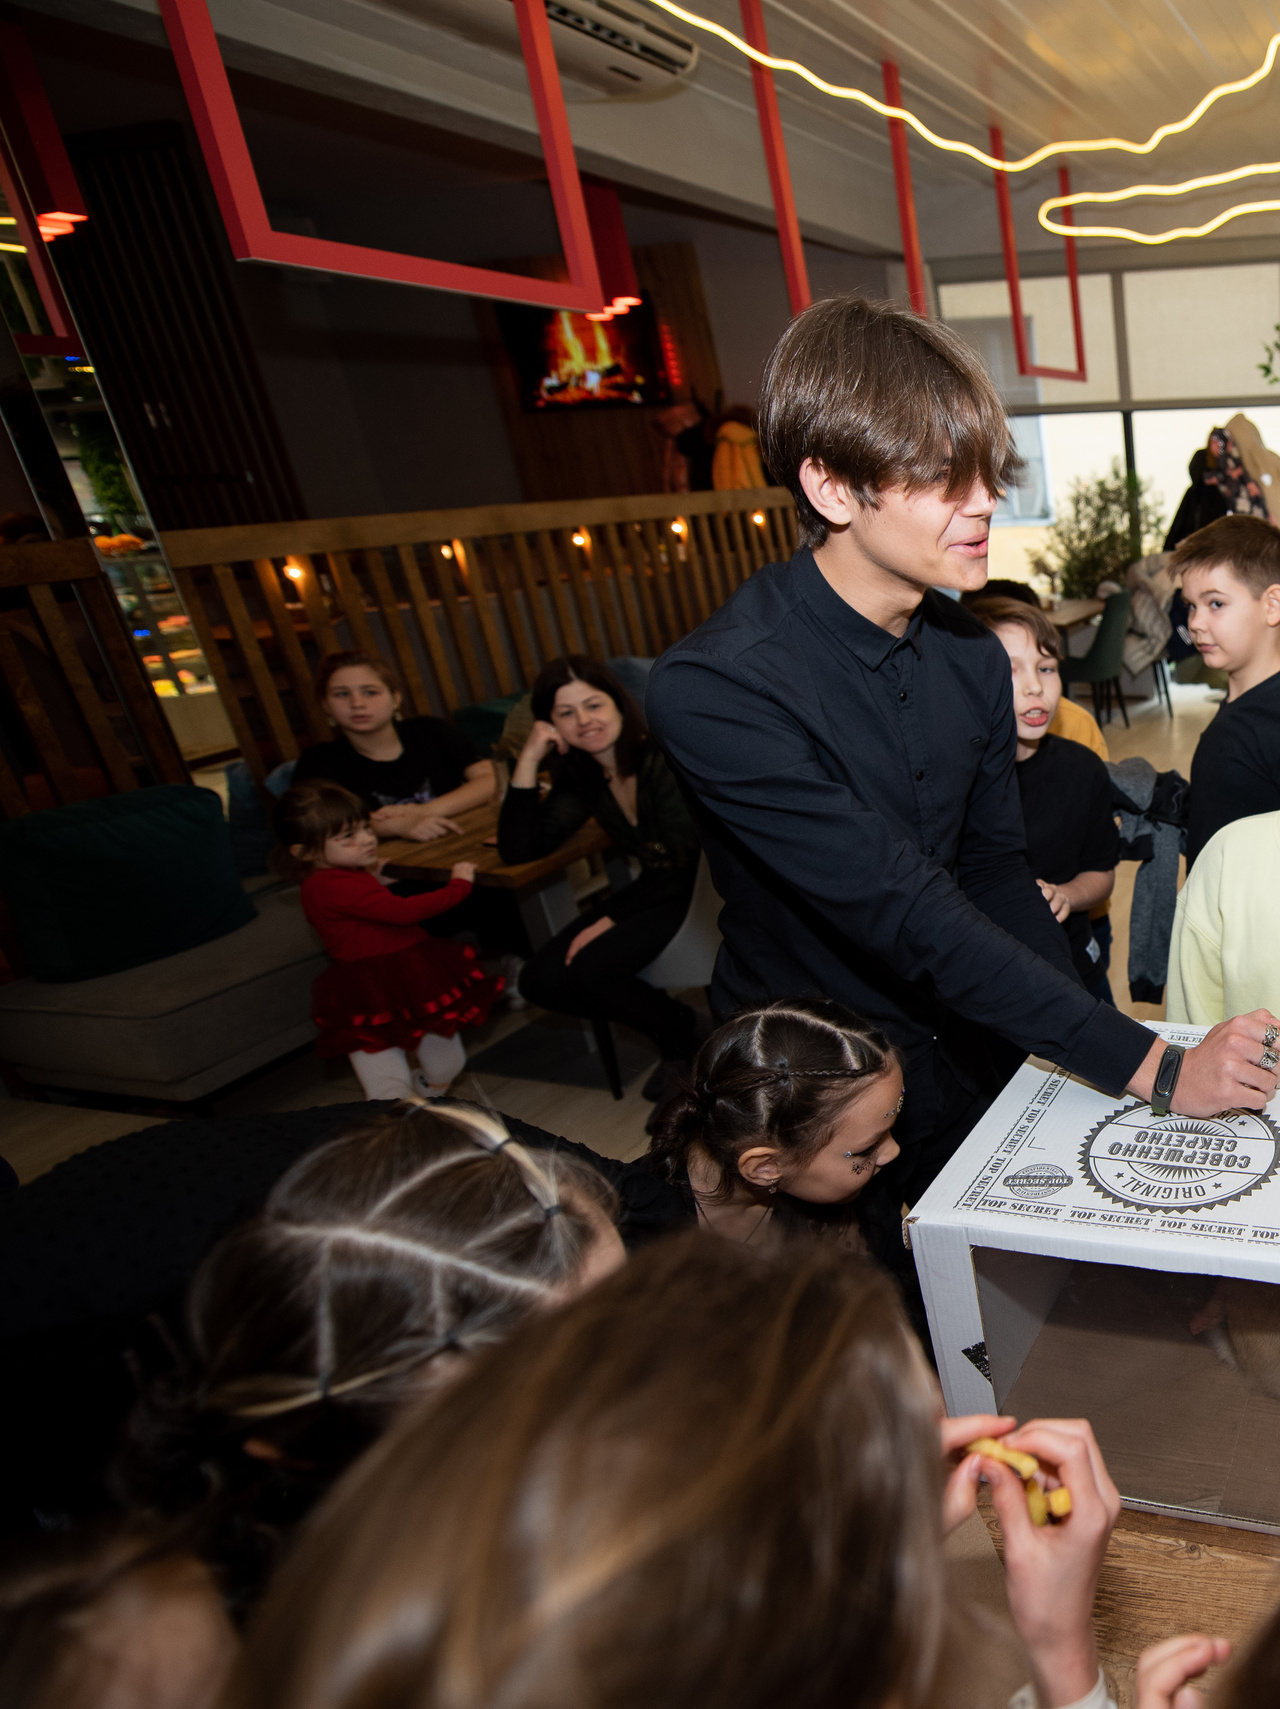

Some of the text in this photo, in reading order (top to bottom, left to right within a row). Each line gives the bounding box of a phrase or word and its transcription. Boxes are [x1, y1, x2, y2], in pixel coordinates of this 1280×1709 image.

[1168, 1034, 1202, 1044] ECRET
[1037, 1079, 1061, 1107] SECRET
[1003, 1108, 1041, 1155] TOP SECRET
[1134, 1130, 1238, 1152] СЕКРЕТНО
[1108, 1142, 1251, 1169] СОВЕРШЕННО
[961, 1157, 1007, 1208] TOP SECRET
[1122, 1176, 1207, 1199] ORIGINAL
[982, 1199, 1063, 1216] TOP SECRET
[1069, 1210, 1153, 1226] TOP SECRET
[1159, 1219, 1246, 1236] TOP SECRET
[1252, 1229, 1279, 1240] TOP
